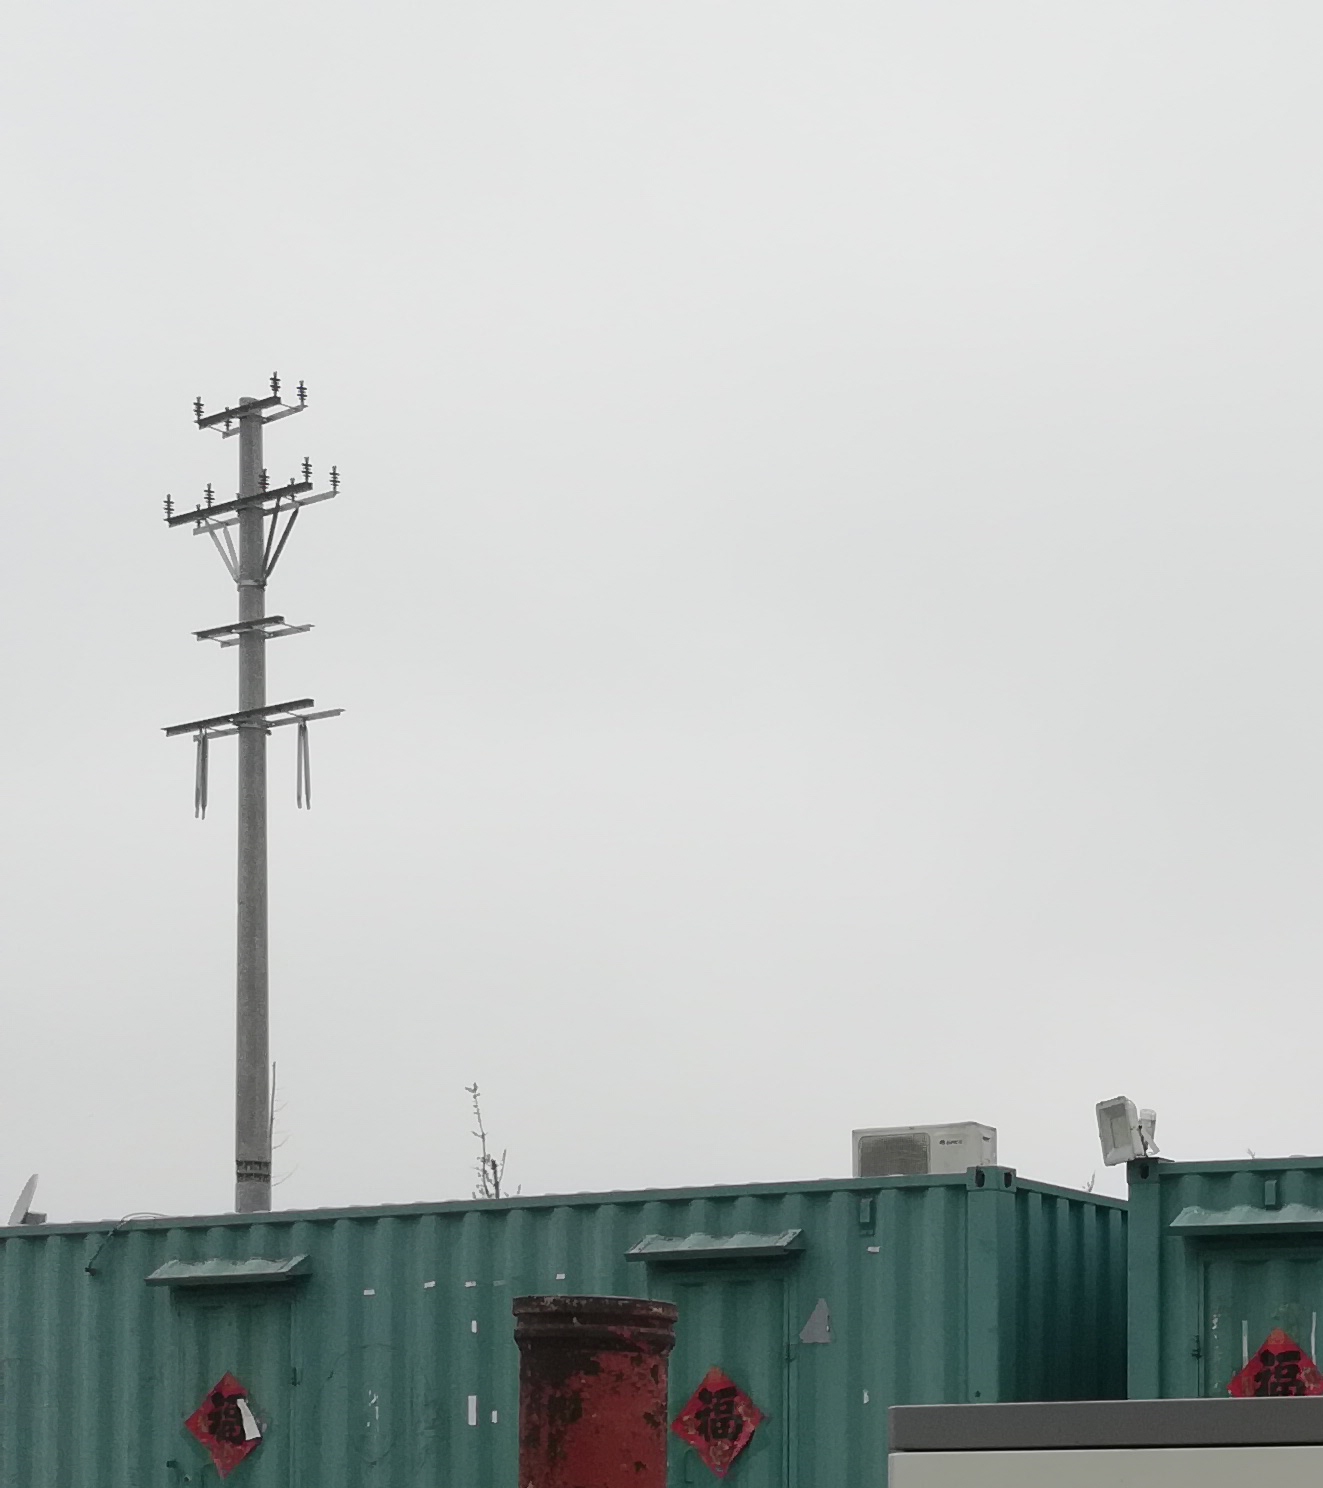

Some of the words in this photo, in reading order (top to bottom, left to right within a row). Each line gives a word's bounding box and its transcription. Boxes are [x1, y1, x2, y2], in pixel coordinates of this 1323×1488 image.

[1254, 1349, 1306, 1396] 福
[207, 1391, 249, 1446] 福
[695, 1386, 744, 1443] 福
